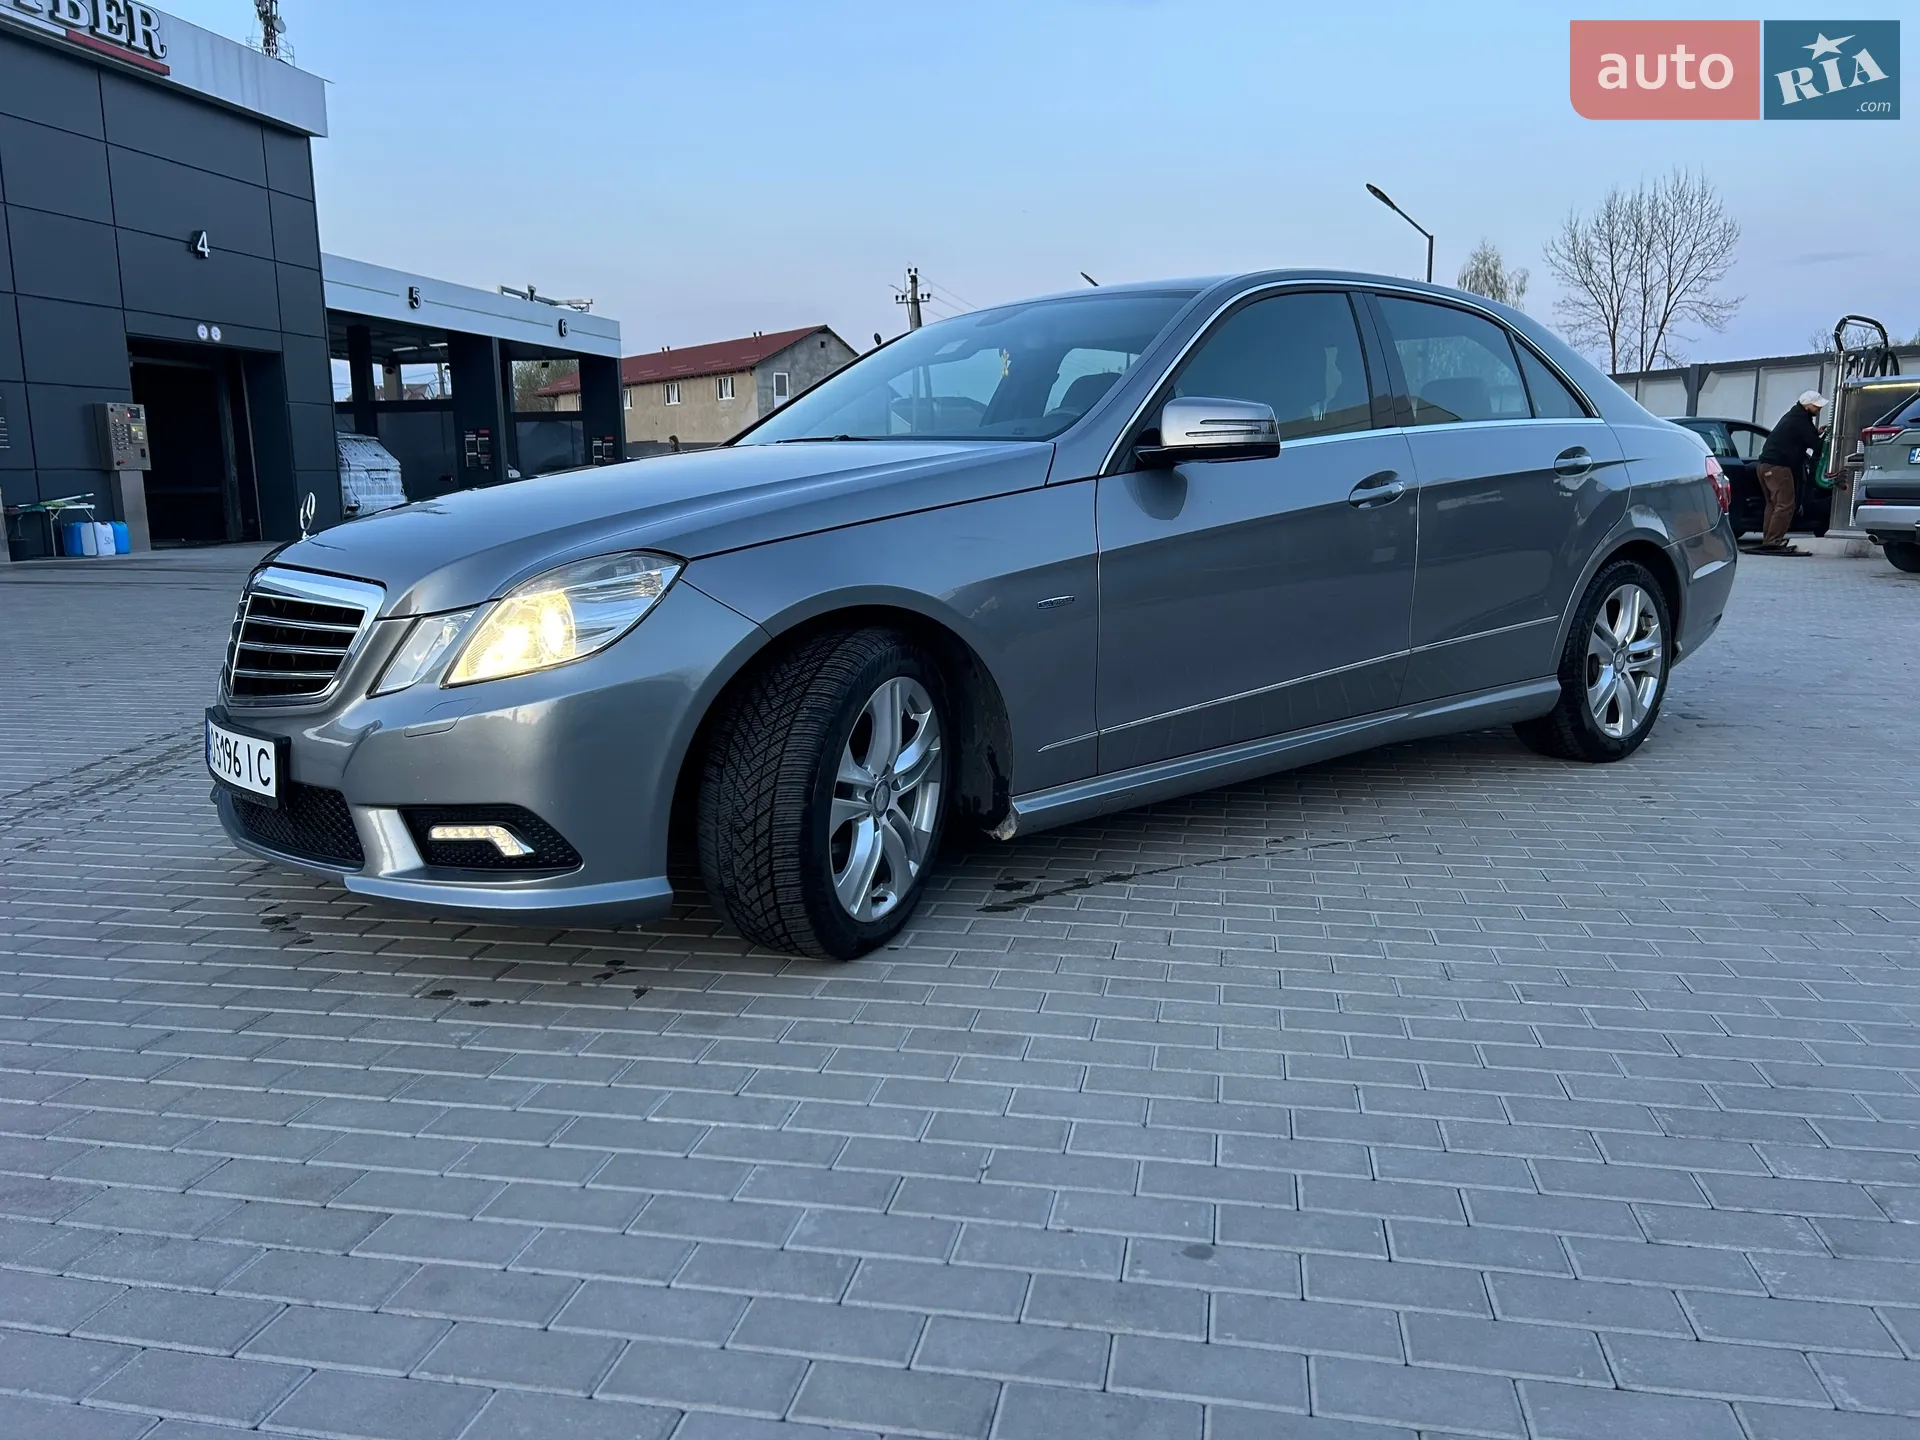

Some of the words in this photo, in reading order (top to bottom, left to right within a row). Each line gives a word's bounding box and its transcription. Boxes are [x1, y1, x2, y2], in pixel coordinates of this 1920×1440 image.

[195, 230, 210, 258] 4
[409, 286, 421, 309] 5
[558, 318, 568, 337] 6
[247, 743, 271, 787] IC
